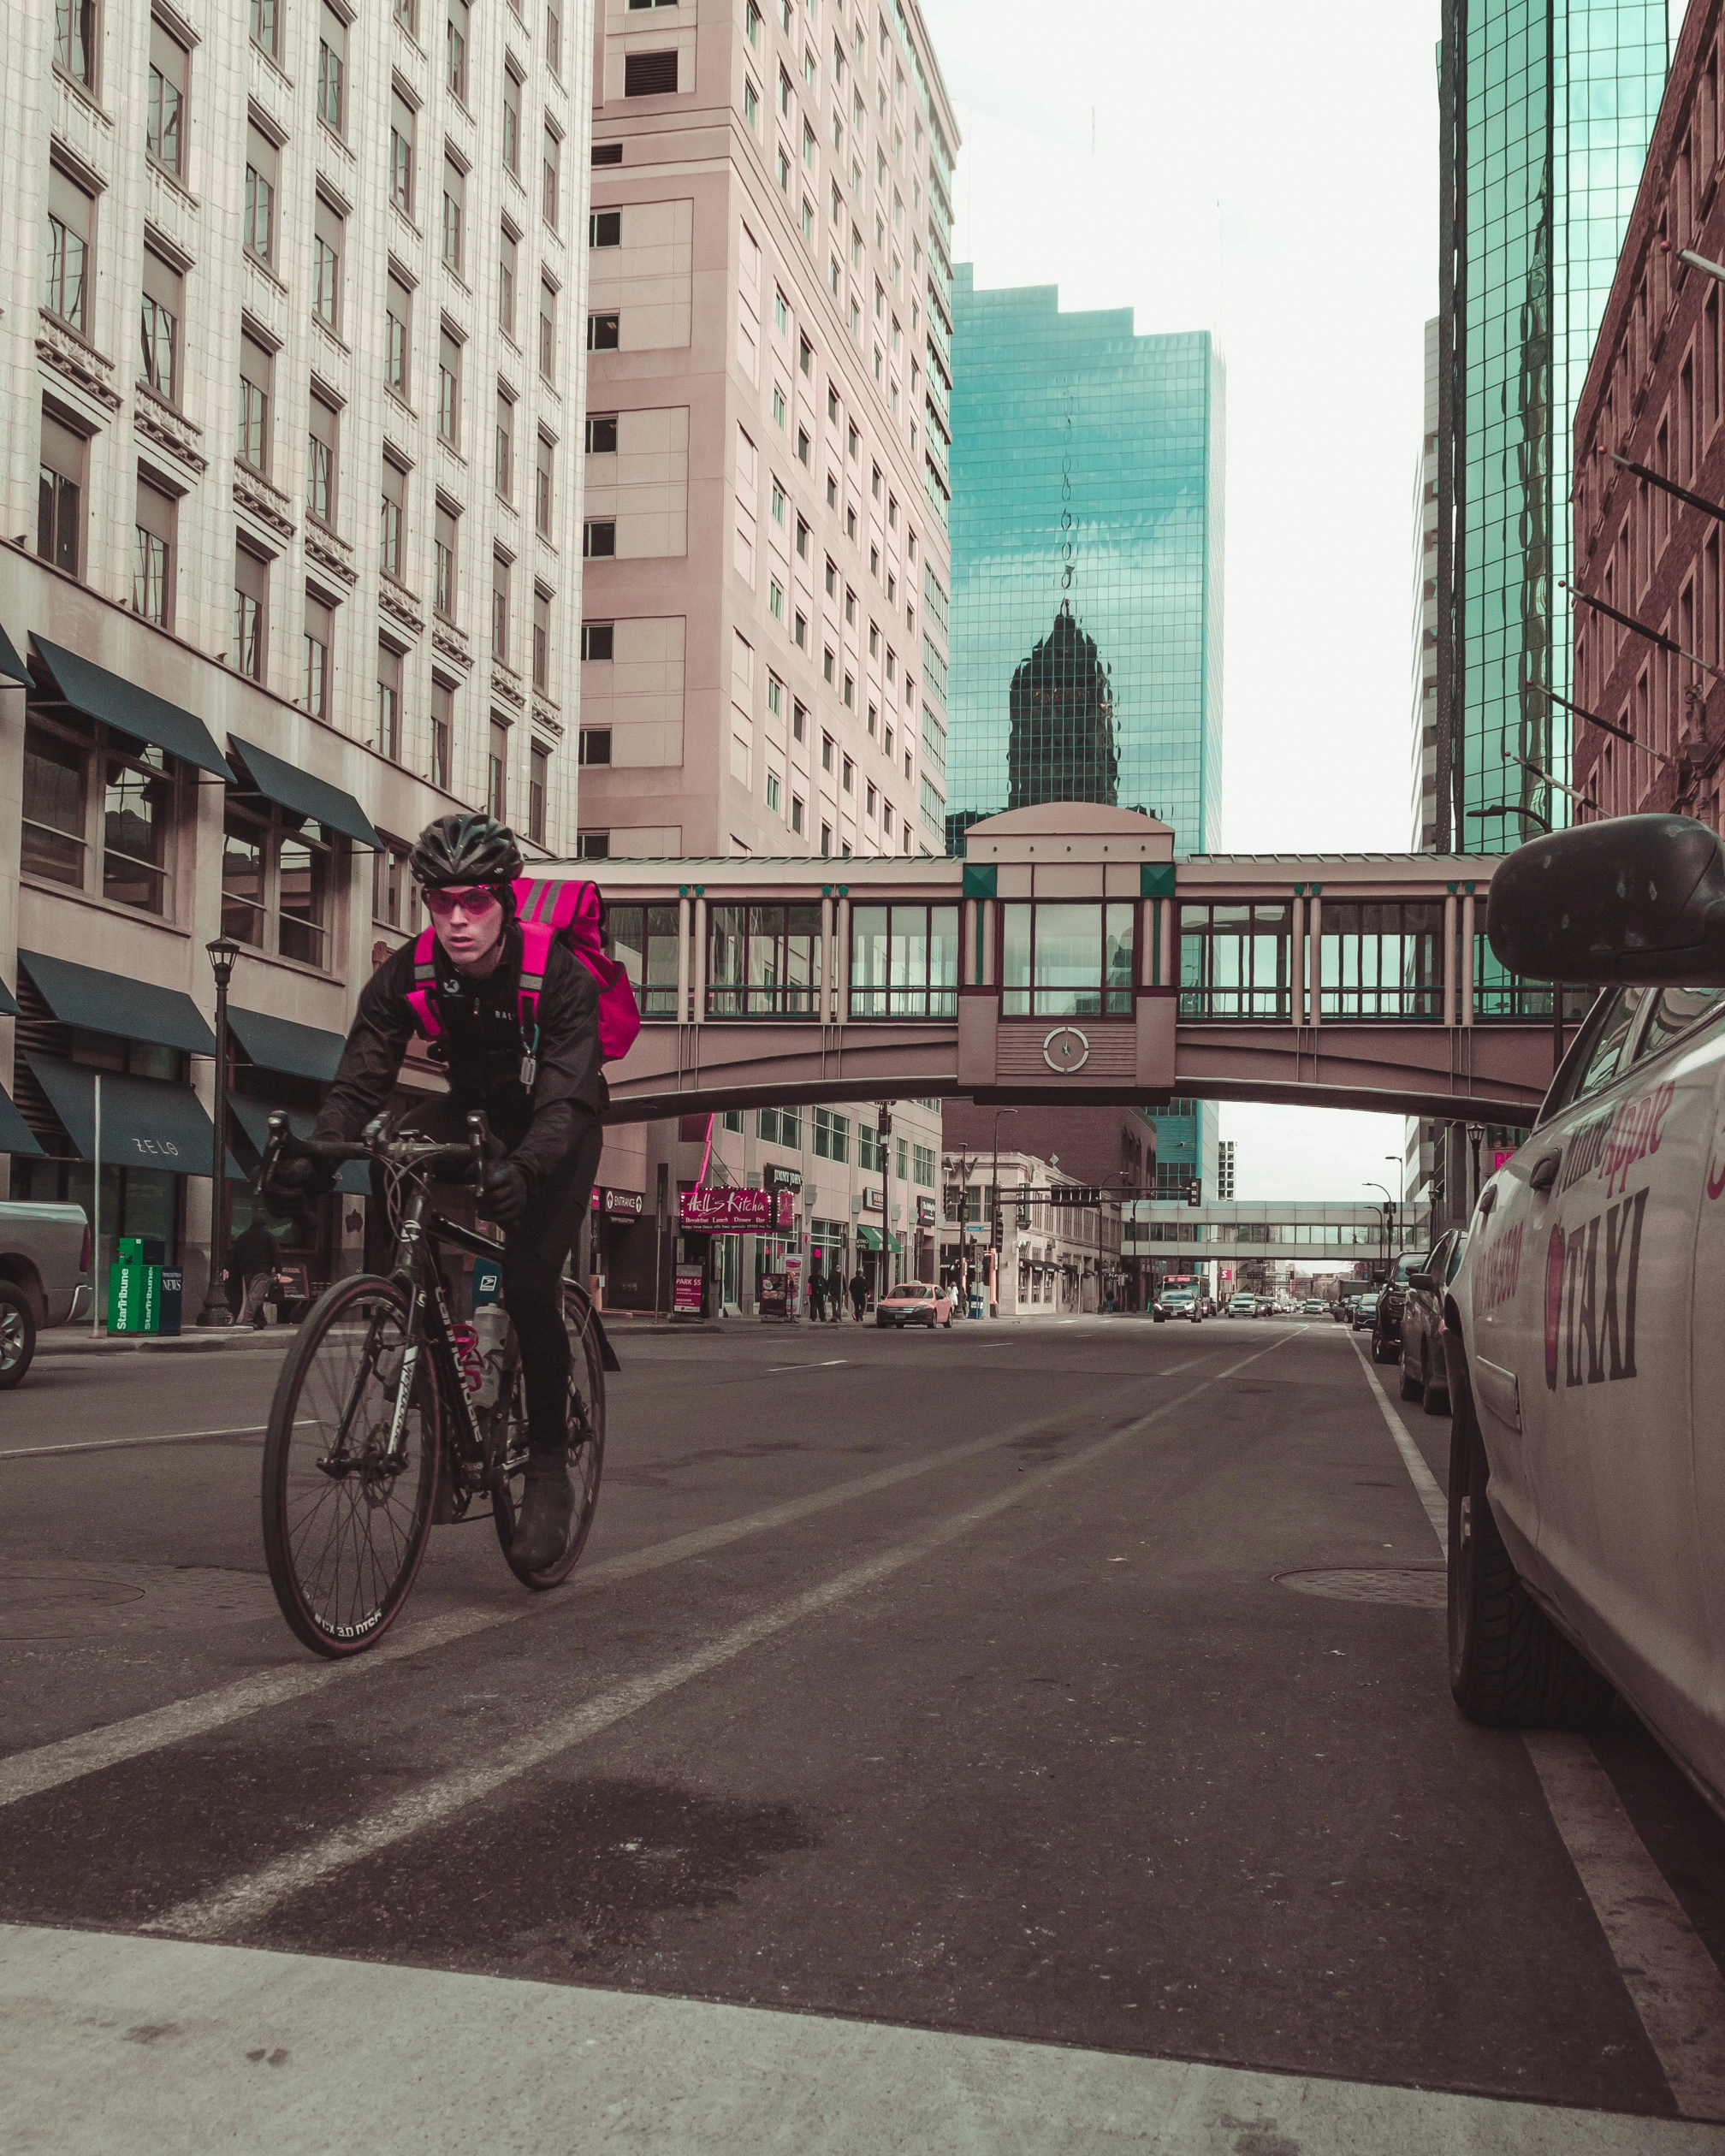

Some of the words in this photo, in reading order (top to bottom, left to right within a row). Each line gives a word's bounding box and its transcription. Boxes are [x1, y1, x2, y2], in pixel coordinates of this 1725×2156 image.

[132, 1138, 178, 1156] ZELO
[774, 1169, 789, 1182] JIMMY
[614, 1195, 636, 1208] ENTRANCE
[687, 1193, 725, 1217] Hell's
[726, 1192, 765, 1212] Kitchen
[162, 1279, 181, 1291] NEWS
[1566, 1187, 1650, 1388] TAXI
[116, 1269, 129, 1330] StarTribune
